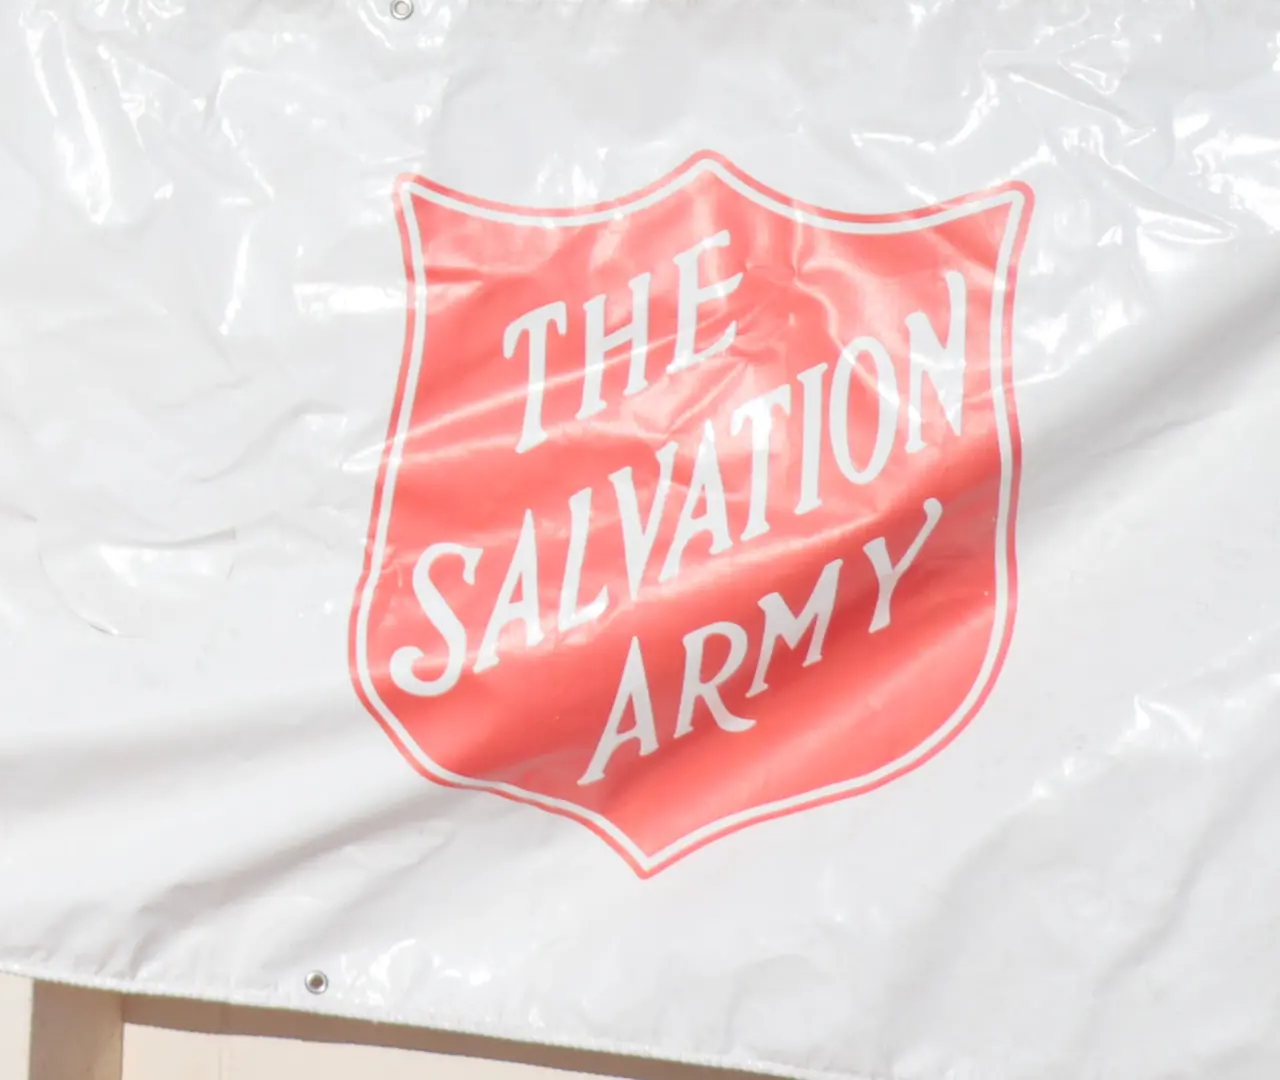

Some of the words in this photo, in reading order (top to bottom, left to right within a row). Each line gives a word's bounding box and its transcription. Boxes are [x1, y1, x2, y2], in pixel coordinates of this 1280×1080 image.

[388, 269, 968, 698] SALVATION
[502, 228, 745, 455] THE
[576, 496, 944, 787] ARMY
